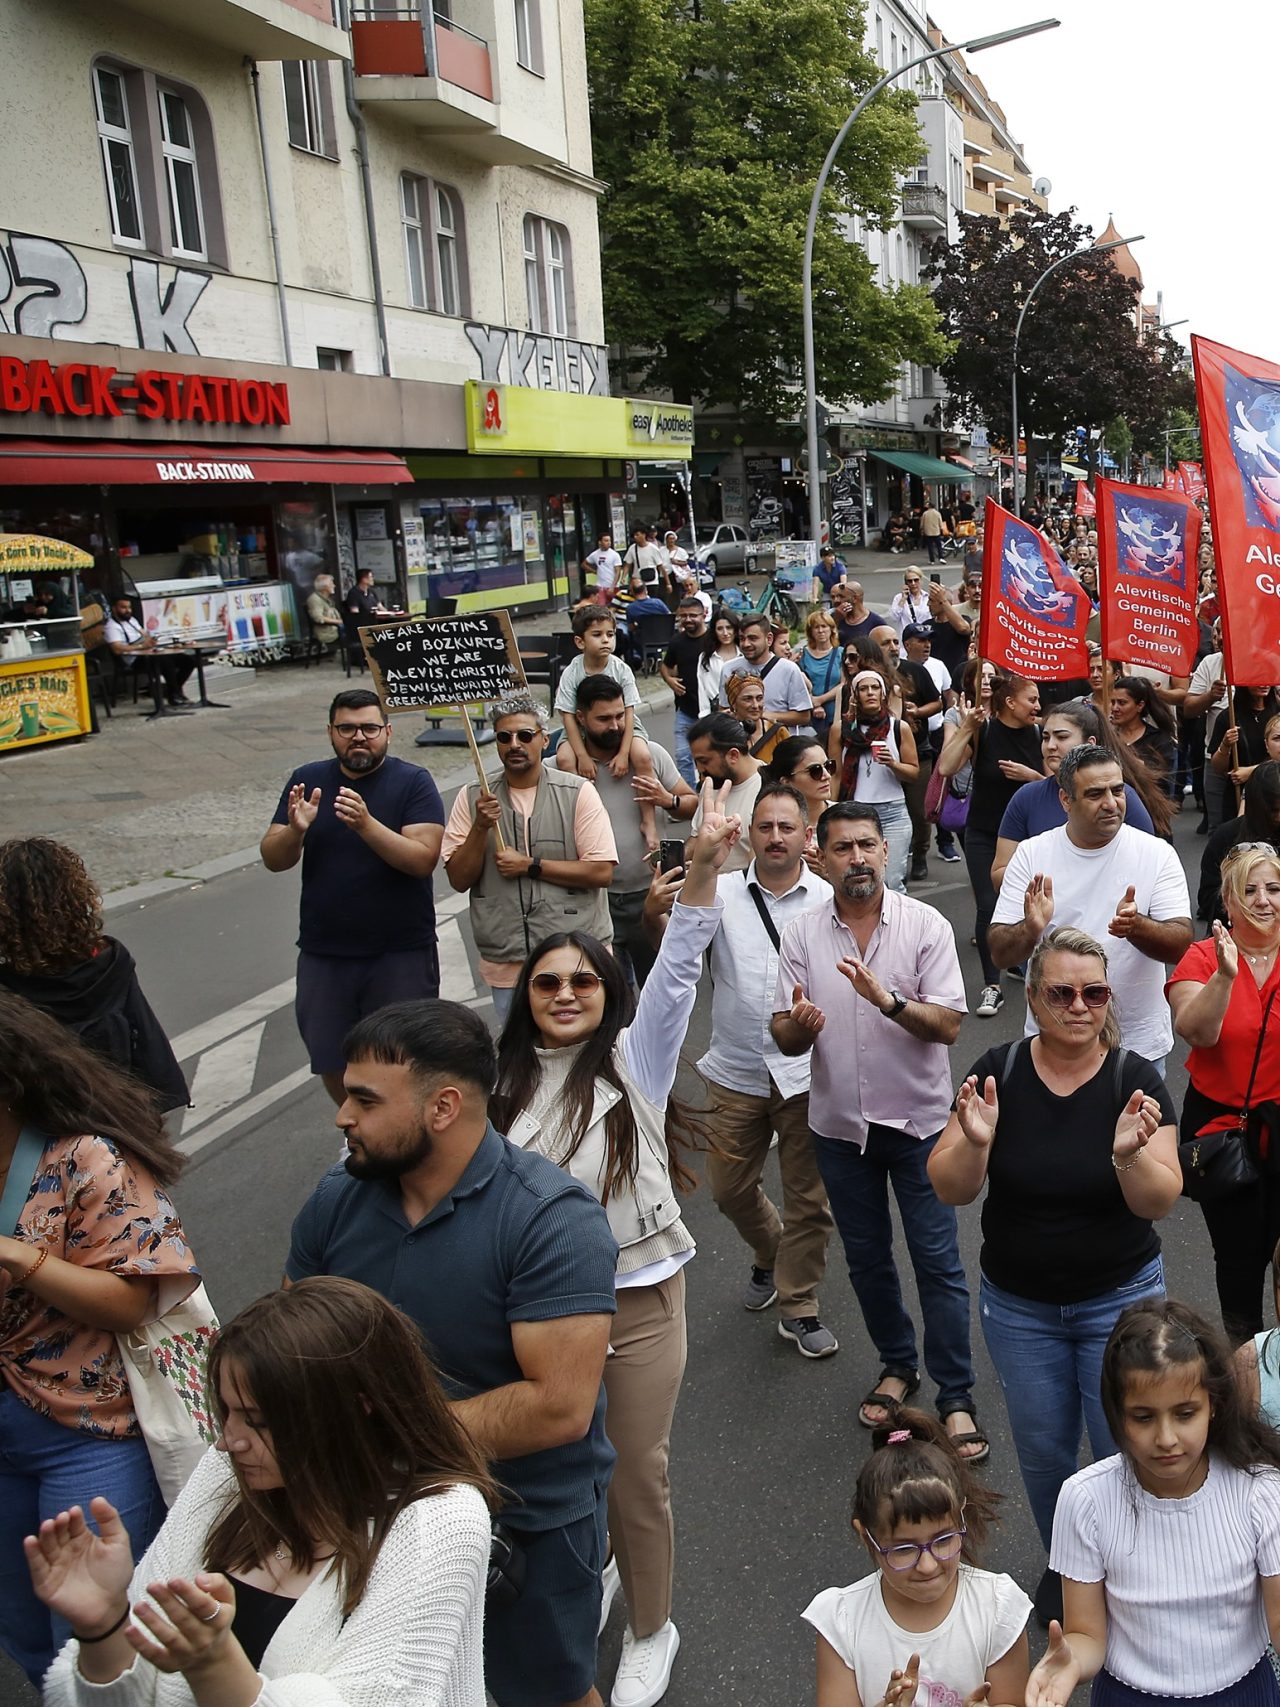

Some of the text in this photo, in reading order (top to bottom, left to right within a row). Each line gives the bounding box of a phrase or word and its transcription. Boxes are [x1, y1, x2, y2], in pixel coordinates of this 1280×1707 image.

[0, 356, 290, 426] BACK-STATION
[633, 413, 692, 435] easy Apotheke
[156, 463, 255, 481] BACK-STATION
[29, 545, 40, 560] By
[1114, 582, 1192, 612] Alevitische
[996, 601, 1079, 644] Alevitische
[1117, 599, 1191, 626] Gemeinde
[373, 620, 489, 643] WE ARE VICTIMS
[998, 616, 1076, 650] Gemeinde
[1133, 617, 1177, 638] Berlin
[396, 637, 505, 652] OF BOZKURTS
[1010, 638, 1058, 661] Berlin
[1128, 633, 1182, 656] Cemevi
[423, 651, 482, 666] WE ARE
[1005, 649, 1065, 671] Cemevi
[40, 676, 68, 693] MAIS
[386, 667, 449, 682] ALEVIS,
